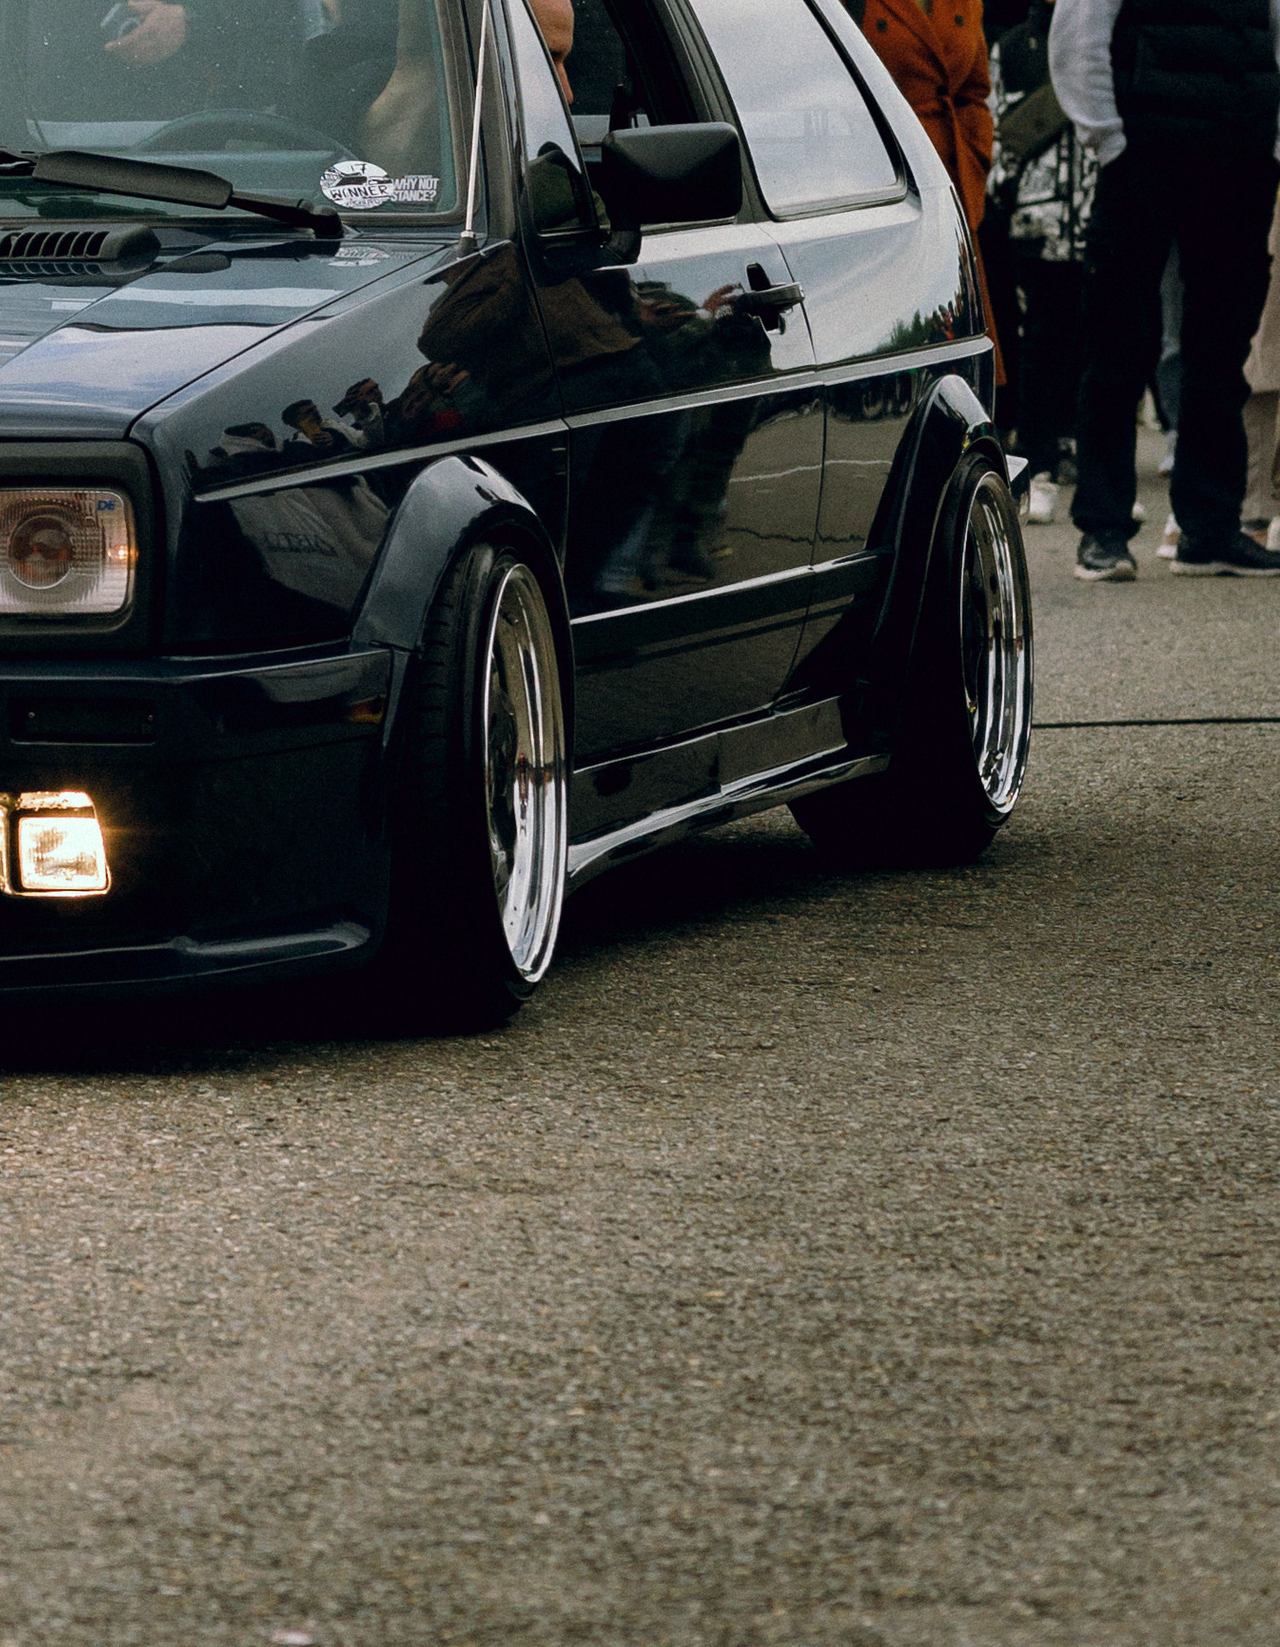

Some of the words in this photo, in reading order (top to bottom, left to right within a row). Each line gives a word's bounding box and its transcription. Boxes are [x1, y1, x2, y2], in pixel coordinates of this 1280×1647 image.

[391, 178, 417, 190] WHY
[418, 177, 440, 190] NOT
[330, 185, 389, 200] WINNER
[390, 190, 437, 202] STANCE?
[96, 499, 116, 511] DE
